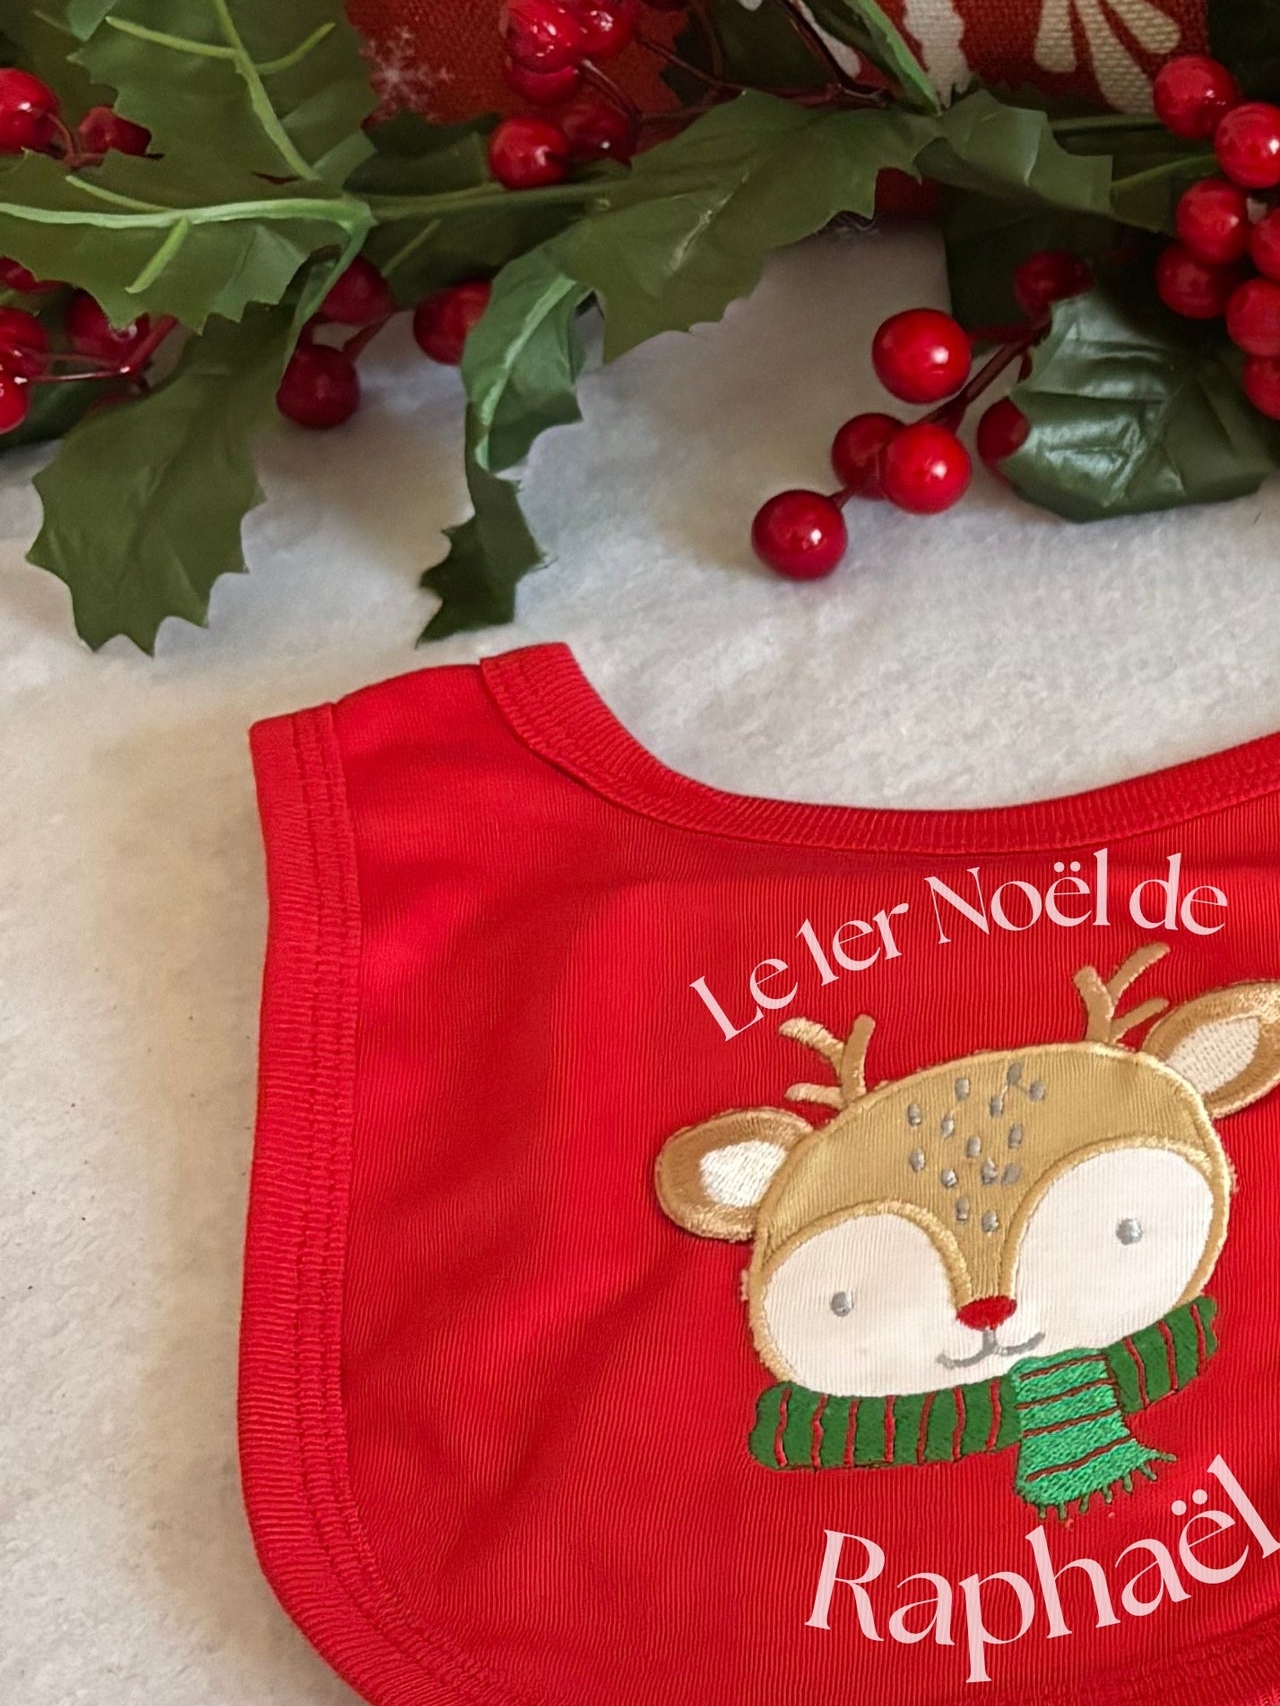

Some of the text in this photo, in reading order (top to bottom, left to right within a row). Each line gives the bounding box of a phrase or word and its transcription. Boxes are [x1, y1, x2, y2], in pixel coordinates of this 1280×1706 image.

[689, 847, 1228, 1042] Le 1er Noël de
